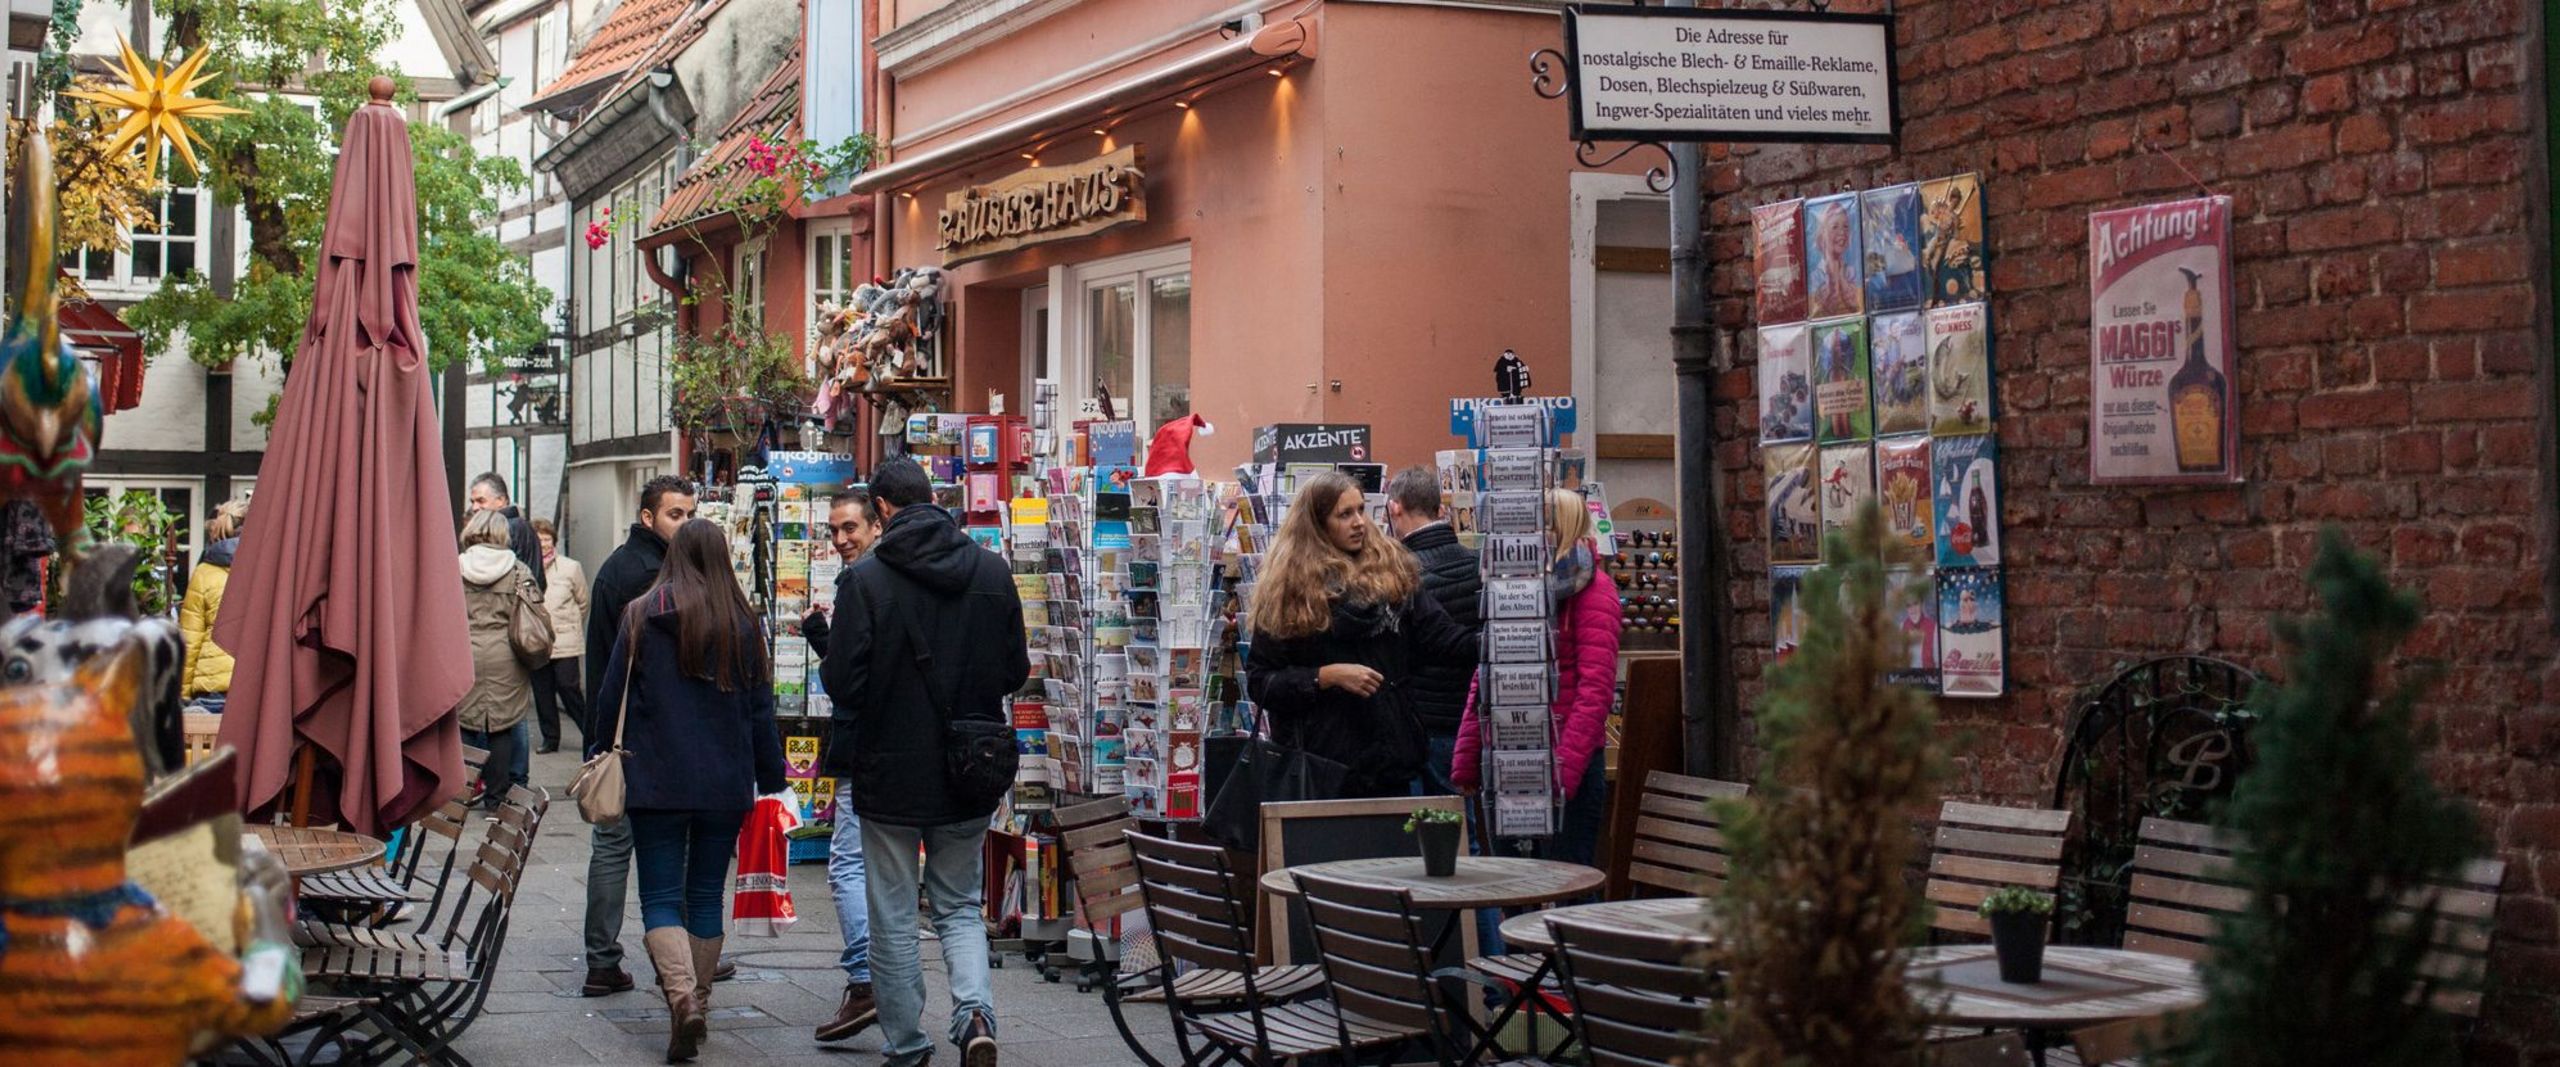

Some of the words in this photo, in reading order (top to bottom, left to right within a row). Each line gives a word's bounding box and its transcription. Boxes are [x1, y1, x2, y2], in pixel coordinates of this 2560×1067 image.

[1675, 27, 1702, 44] Die
[1706, 28, 1764, 46] Adresse
[1767, 30, 1789, 46] für
[1583, 51, 1677, 72] nostalgische
[1681, 52, 1729, 70] Blech-
[1733, 54, 1747, 70] &
[1751, 55, 1879, 75] Emaille-Reklame,
[1599, 76, 1653, 95] Dosen,
[1657, 78, 1768, 98] Blechspielzeug
[1772, 80, 1785, 95] &
[1788, 80, 1867, 99] Süßwaren,
[1596, 102, 1750, 123] Ingwer-Spezialitäten
[1754, 104, 1783, 121] und
[1787, 105, 1828, 122] vieles
[1832, 106, 1872, 123] mehr.
[2143, 302, 2157, 315] Sie
[1935, 320, 1973, 334] GUINNESS
[502, 353, 553, 368] stein-zeit
[2110, 364, 2164, 388] Würze
[1453, 397, 1573, 411] inkonito
[1089, 421, 1134, 438] inkognito
[1284, 429, 1362, 450] AKZENTE
[769, 451, 853, 464] inkognito
[1493, 539, 1538, 562] Heim
[1511, 711, 1528, 724] WC
